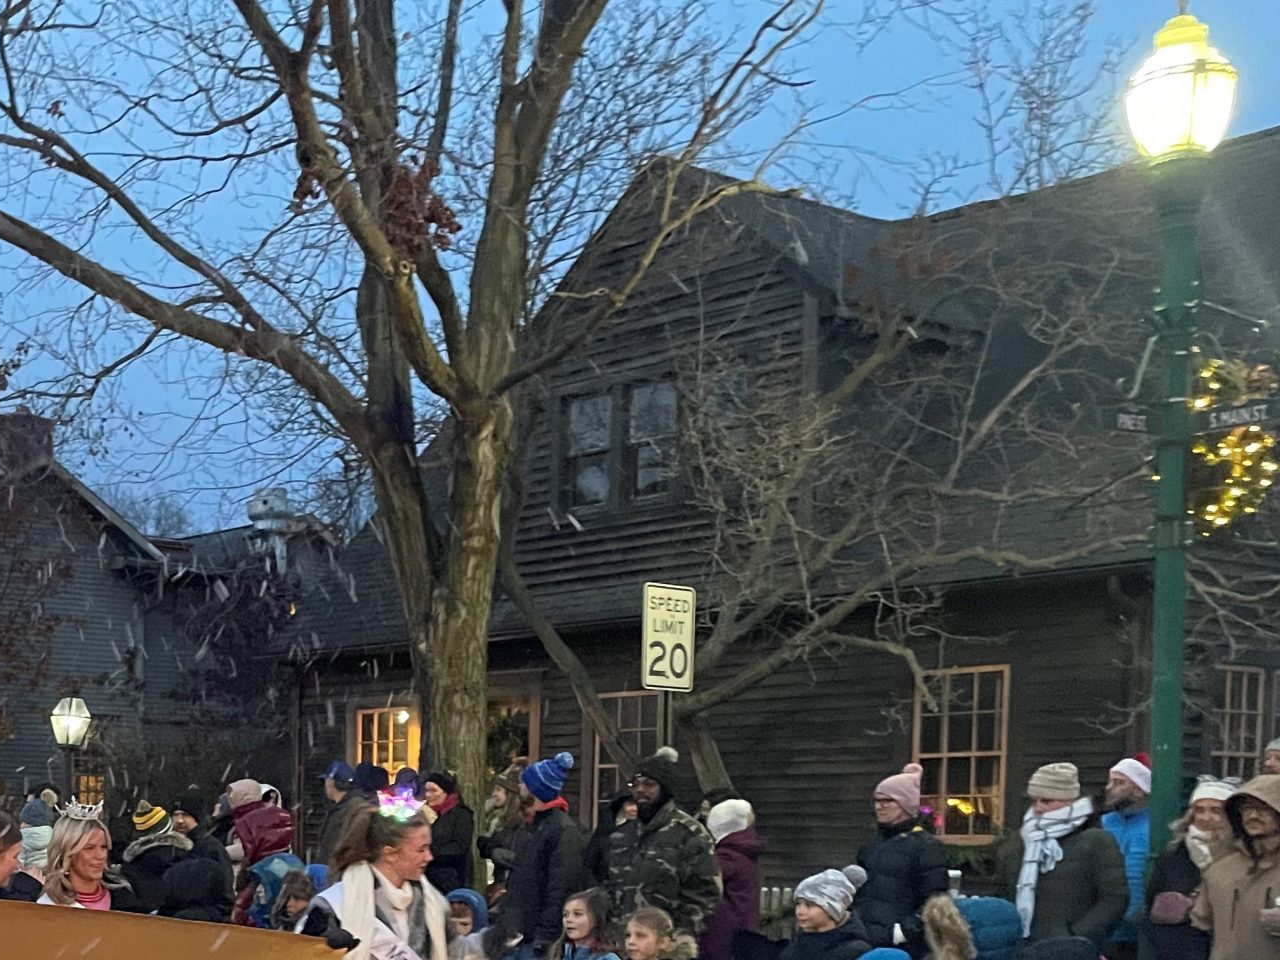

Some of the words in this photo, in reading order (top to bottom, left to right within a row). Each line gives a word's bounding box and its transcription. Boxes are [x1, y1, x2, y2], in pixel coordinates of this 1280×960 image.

[650, 596, 690, 613] SPEED
[653, 618, 685, 635] LIMIT
[649, 640, 688, 679] 20
